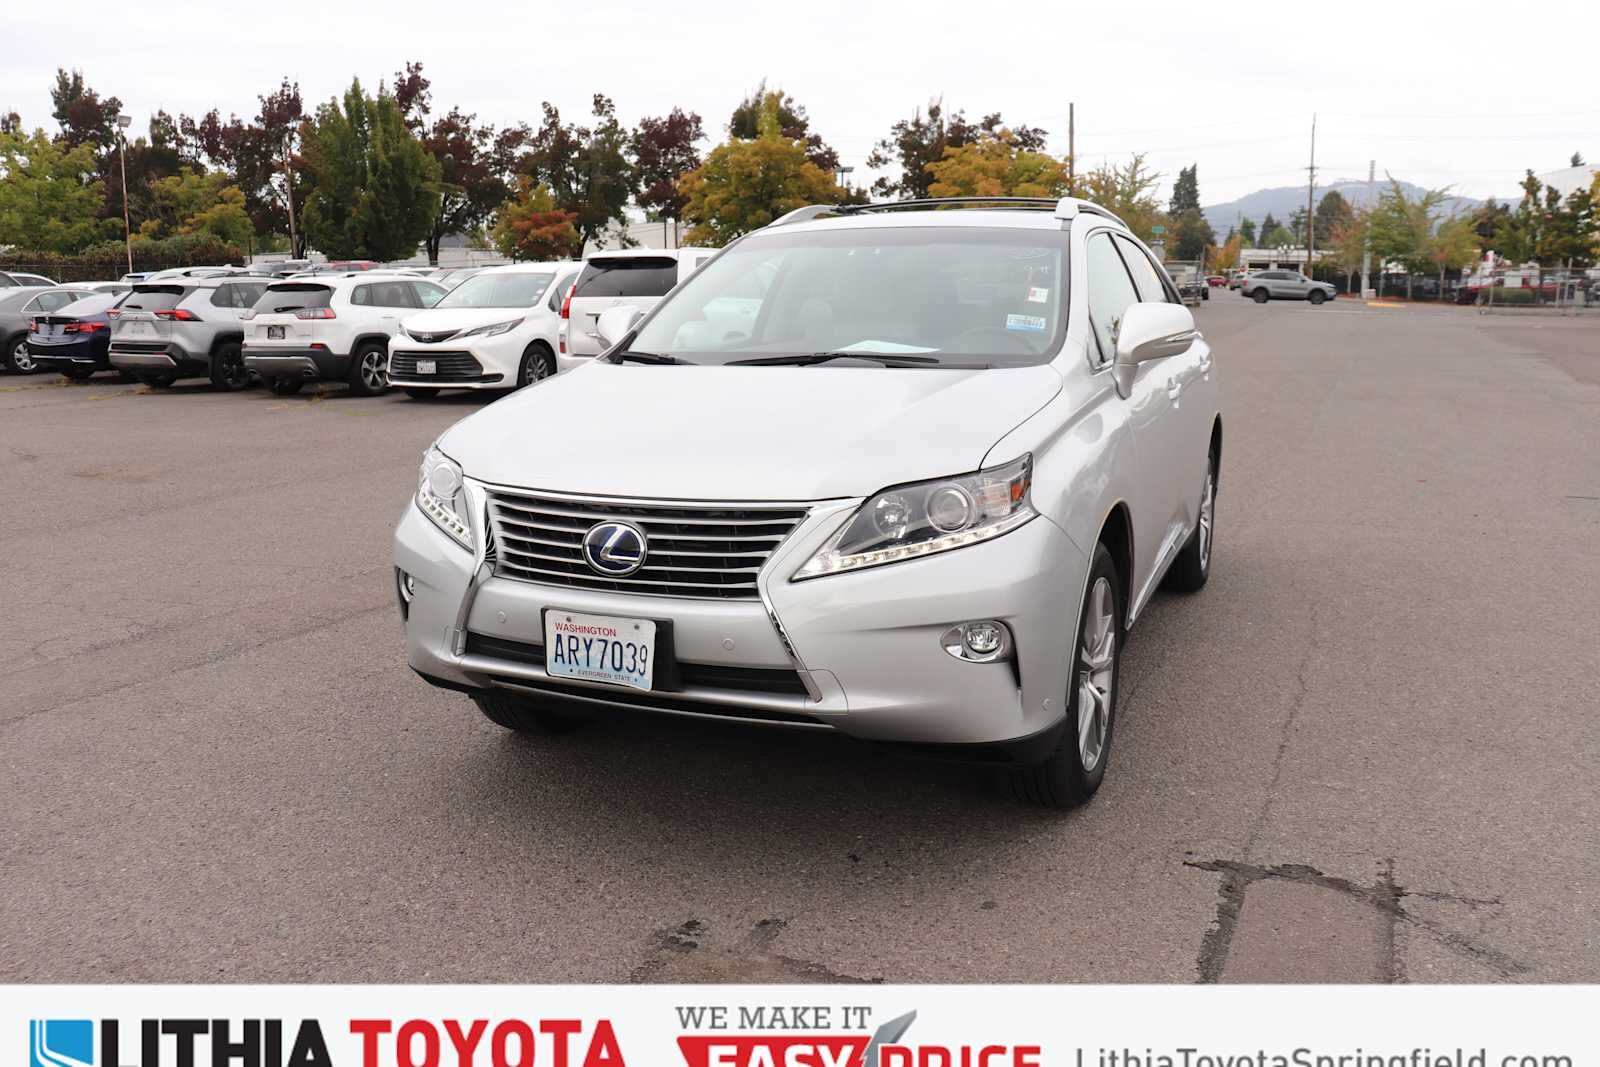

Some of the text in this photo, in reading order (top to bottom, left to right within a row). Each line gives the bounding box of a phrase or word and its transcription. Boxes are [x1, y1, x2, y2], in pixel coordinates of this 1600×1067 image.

[555, 622, 617, 637] WASHINGTON
[554, 633, 648, 676] ARY7039
[577, 669, 630, 681] EVERGREEN STATE
